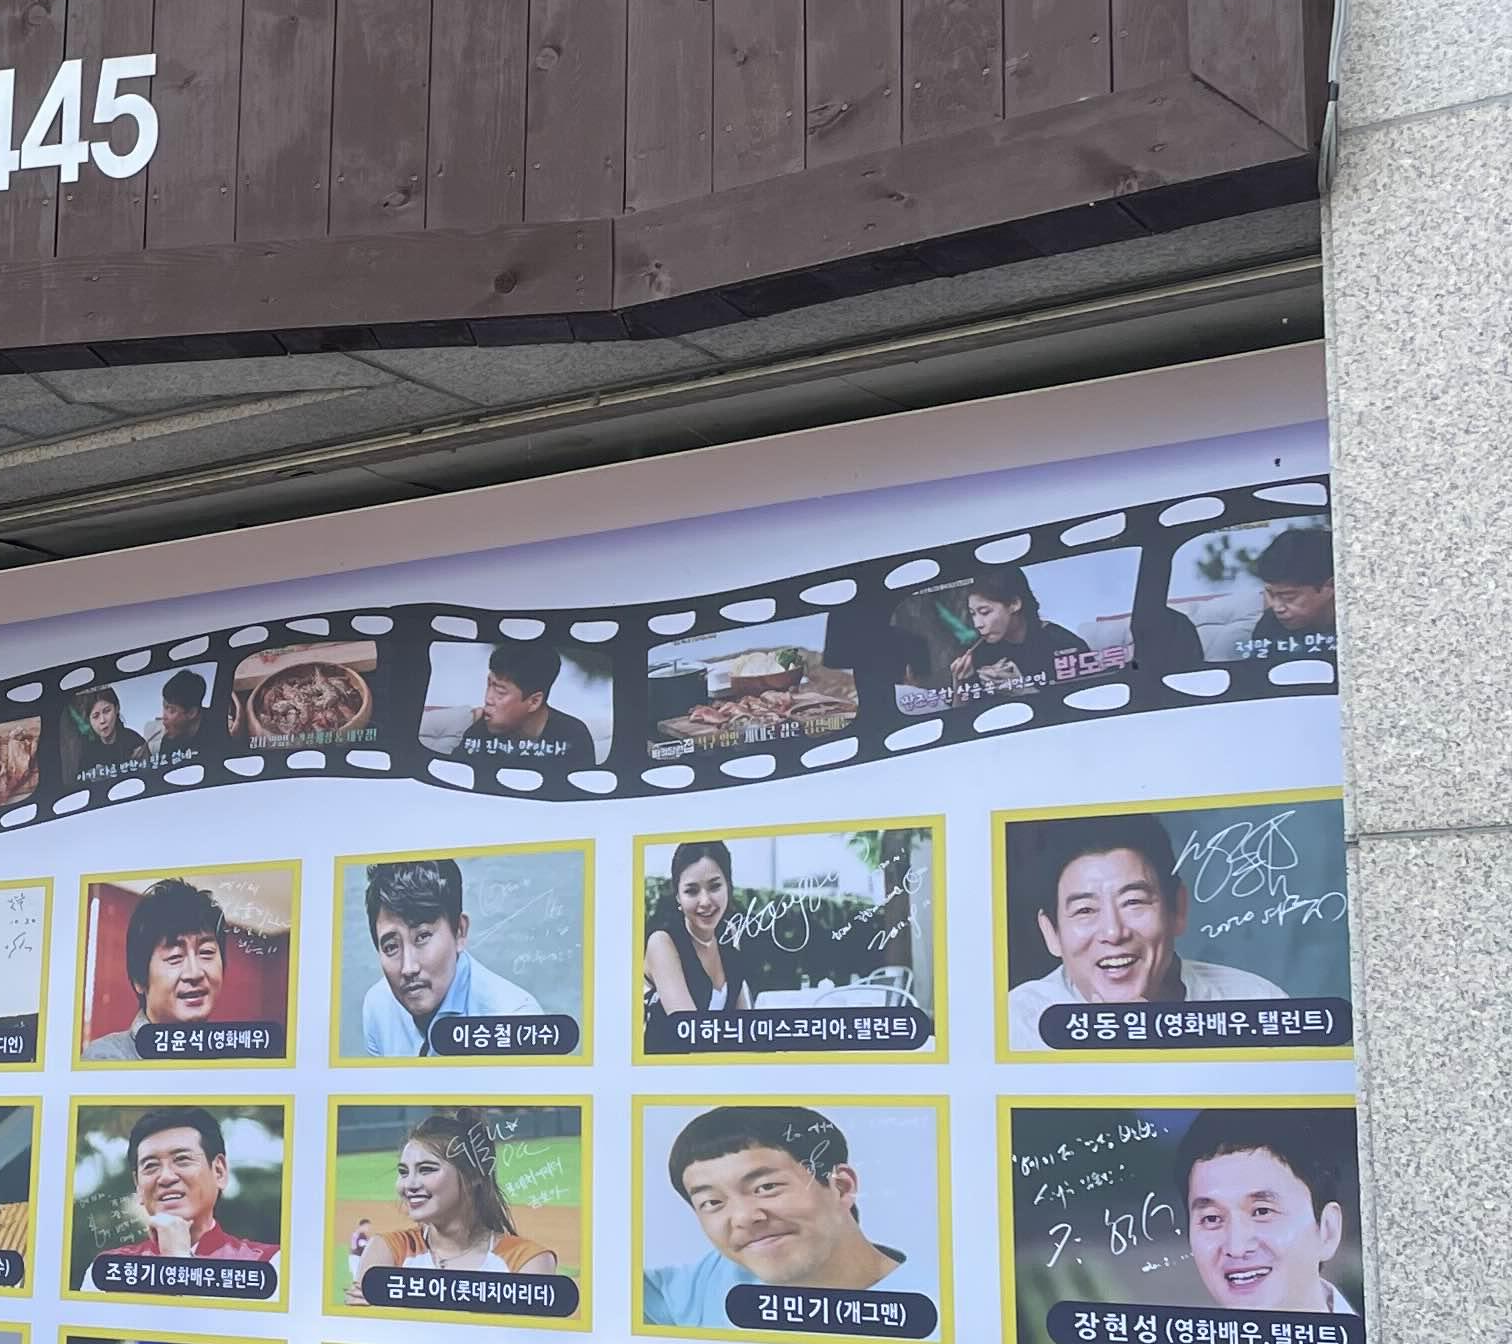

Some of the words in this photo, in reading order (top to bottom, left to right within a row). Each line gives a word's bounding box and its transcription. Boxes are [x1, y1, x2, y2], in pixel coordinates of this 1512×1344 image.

[1235, 638, 1272, 659] 정말
[1277, 636, 1299, 652] 다
[452, 1023, 512, 1049] 이승철
[516, 1024, 560, 1047] (가수)
[677, 1019, 744, 1044] 이하늬
[1066, 1012, 1148, 1041] 성동일
[154, 1030, 204, 1052] 김윤석
[207, 1029, 270, 1050] (영화배우)
[105, 1262, 156, 1286] 조형기
[386, 1275, 448, 1302] 금보아
[450, 1279, 555, 1307] (롯데치어리더)
[757, 1293, 829, 1324] 김민기
[836, 1300, 907, 1327] (개그맨)
[1074, 1311, 1158, 1344] 장현성
